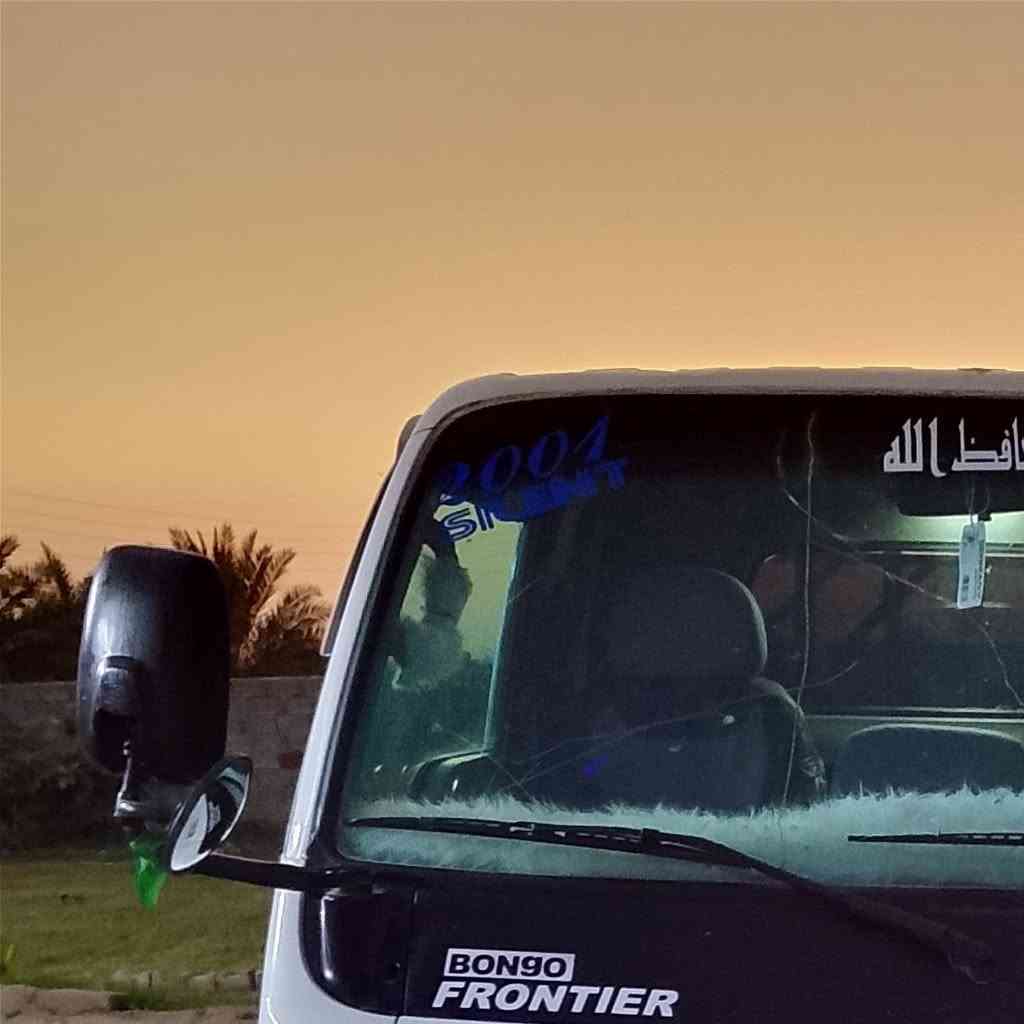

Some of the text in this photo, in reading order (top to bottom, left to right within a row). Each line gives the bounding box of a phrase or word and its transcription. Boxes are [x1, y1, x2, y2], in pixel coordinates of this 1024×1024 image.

[883, 416, 947, 478] الله
[440, 458, 627, 543] SIT
[431, 980, 680, 1018] FRONTIER
